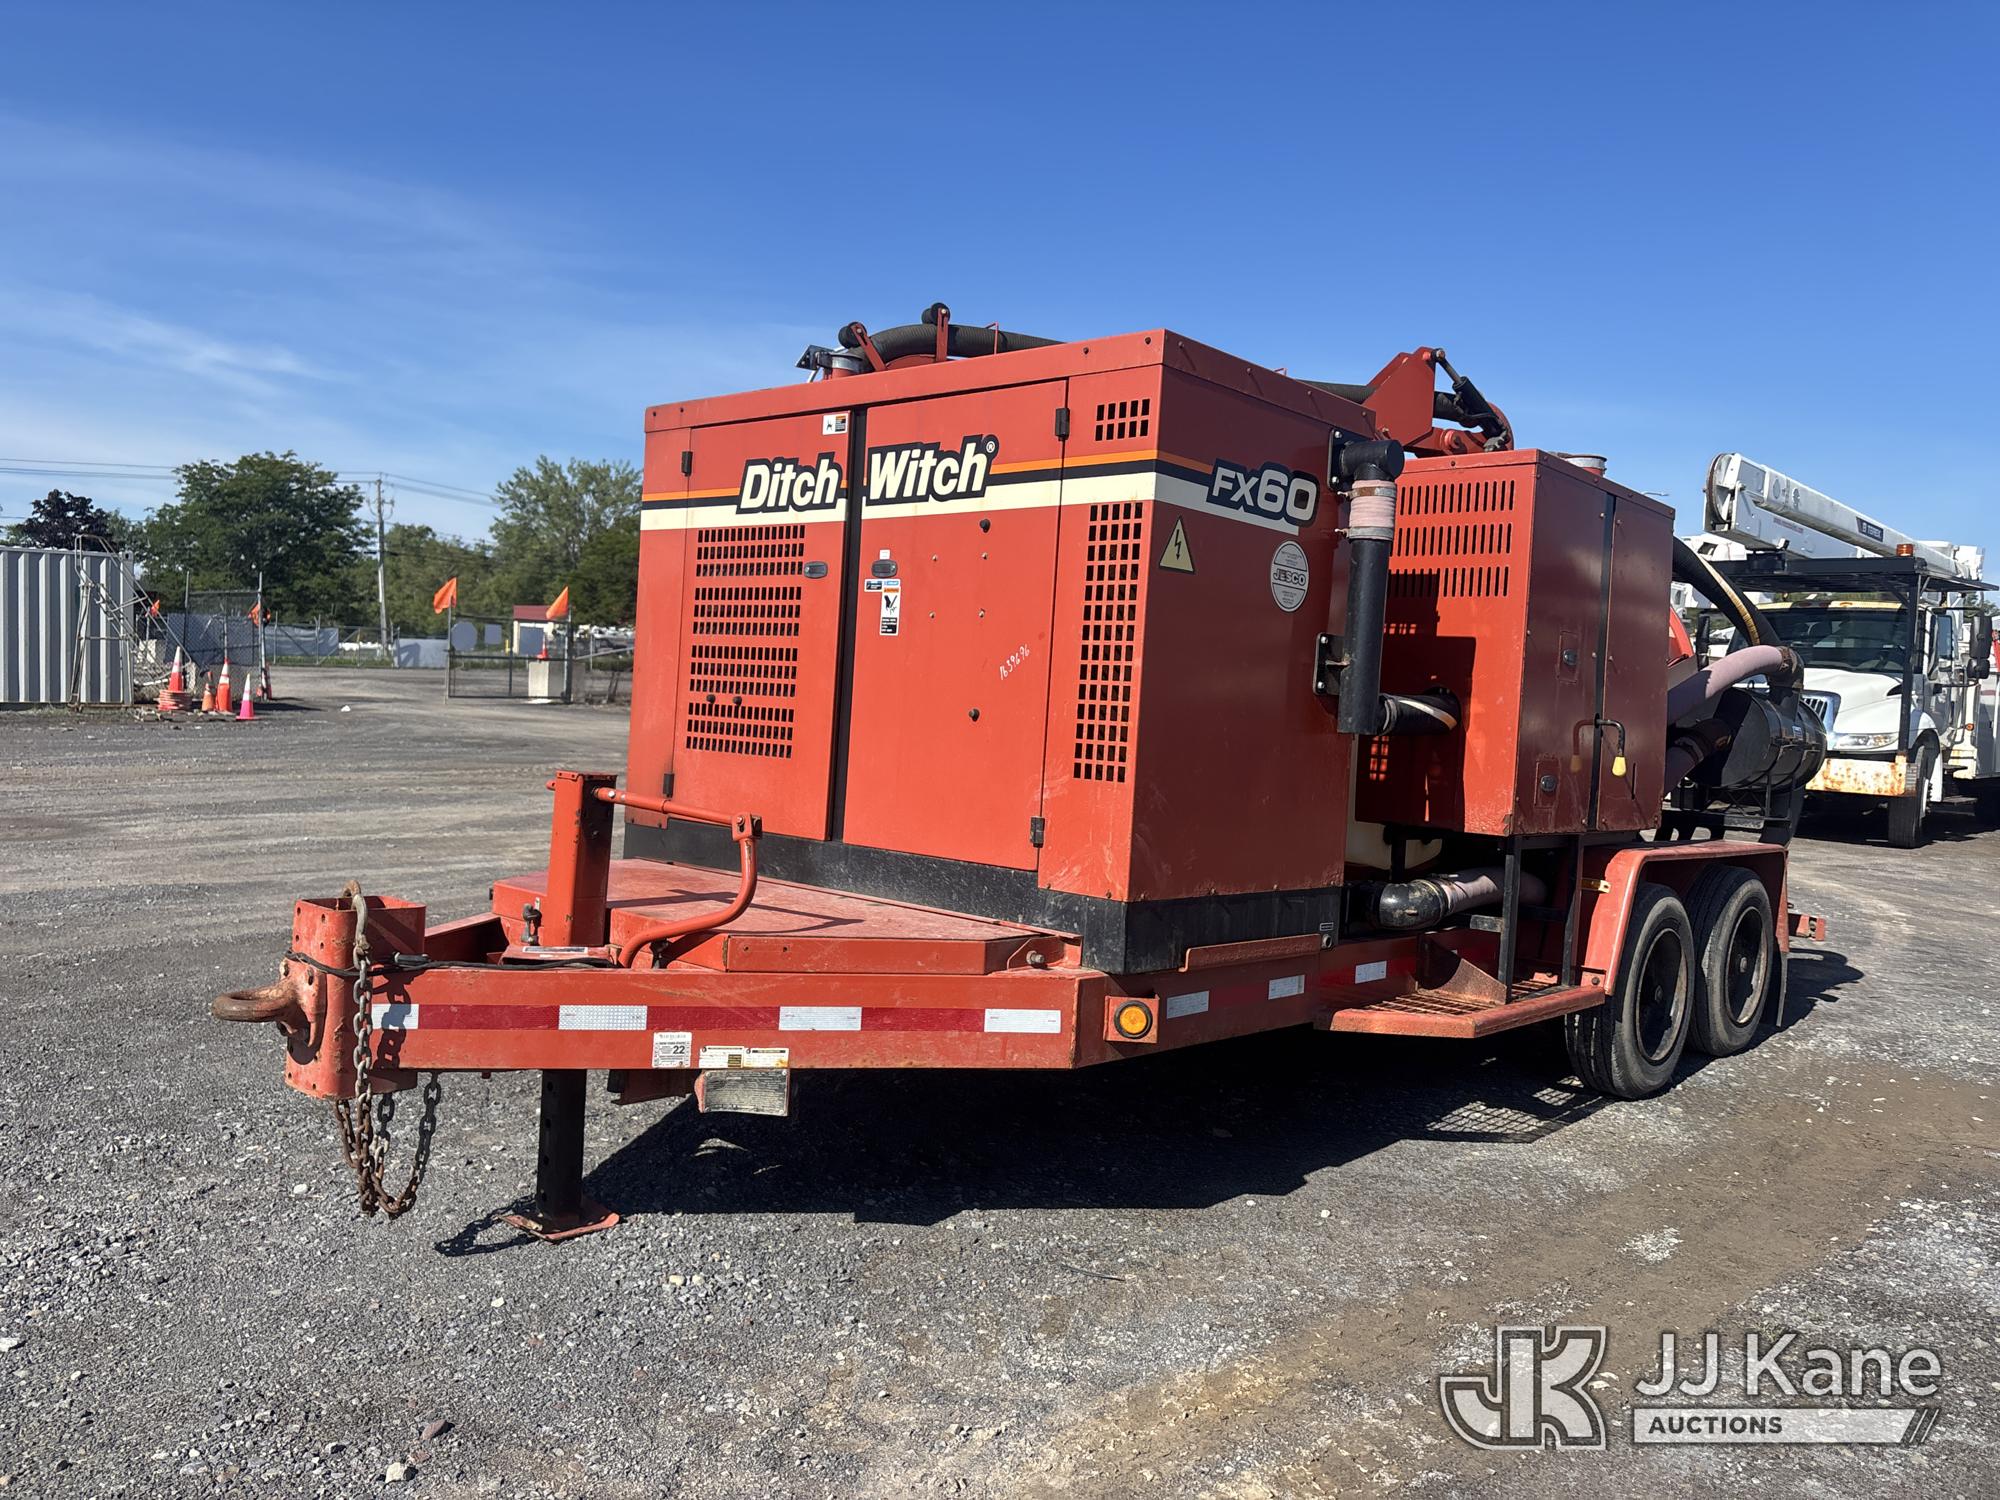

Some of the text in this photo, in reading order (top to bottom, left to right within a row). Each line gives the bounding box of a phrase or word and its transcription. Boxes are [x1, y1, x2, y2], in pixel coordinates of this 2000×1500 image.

[740, 458, 839, 509] Ditch
[1212, 466, 1317, 521] FX60
[1273, 568, 1306, 587] JESCO
[672, 1045, 686, 1055] 22
